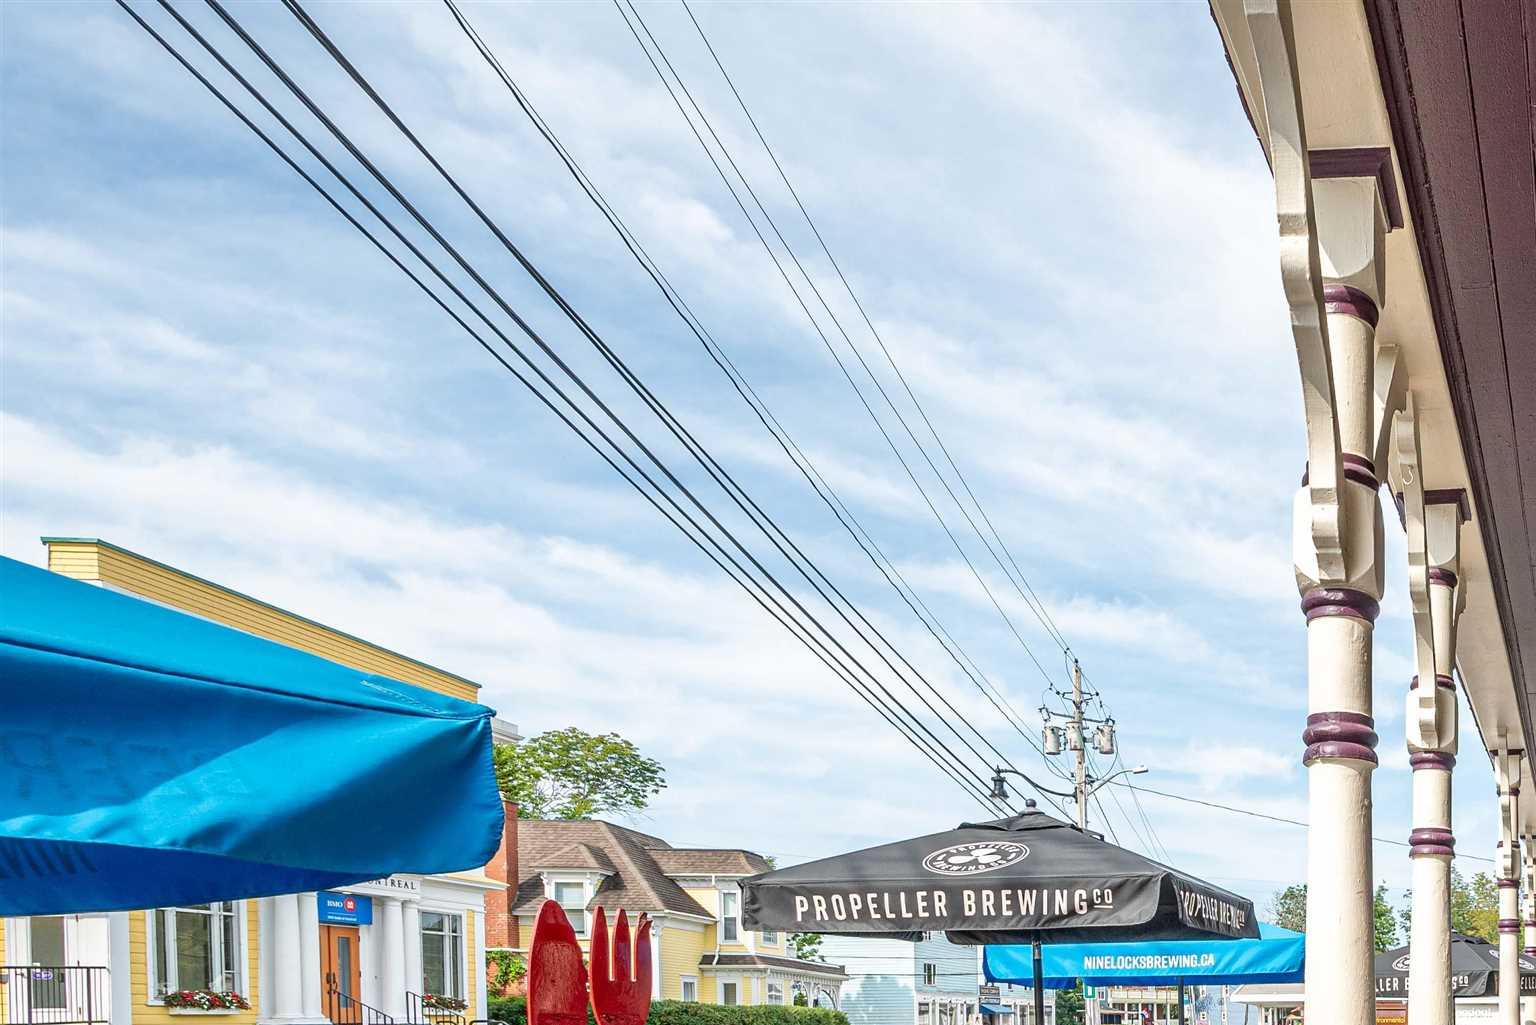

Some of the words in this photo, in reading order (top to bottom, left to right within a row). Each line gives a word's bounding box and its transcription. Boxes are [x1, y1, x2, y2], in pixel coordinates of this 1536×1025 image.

[795, 890, 948, 922] PROPELLER
[963, 888, 1088, 917] BREWING
[1093, 888, 1112, 906] CO
[1083, 952, 1216, 971] NINELOCKSBREWING.CA
